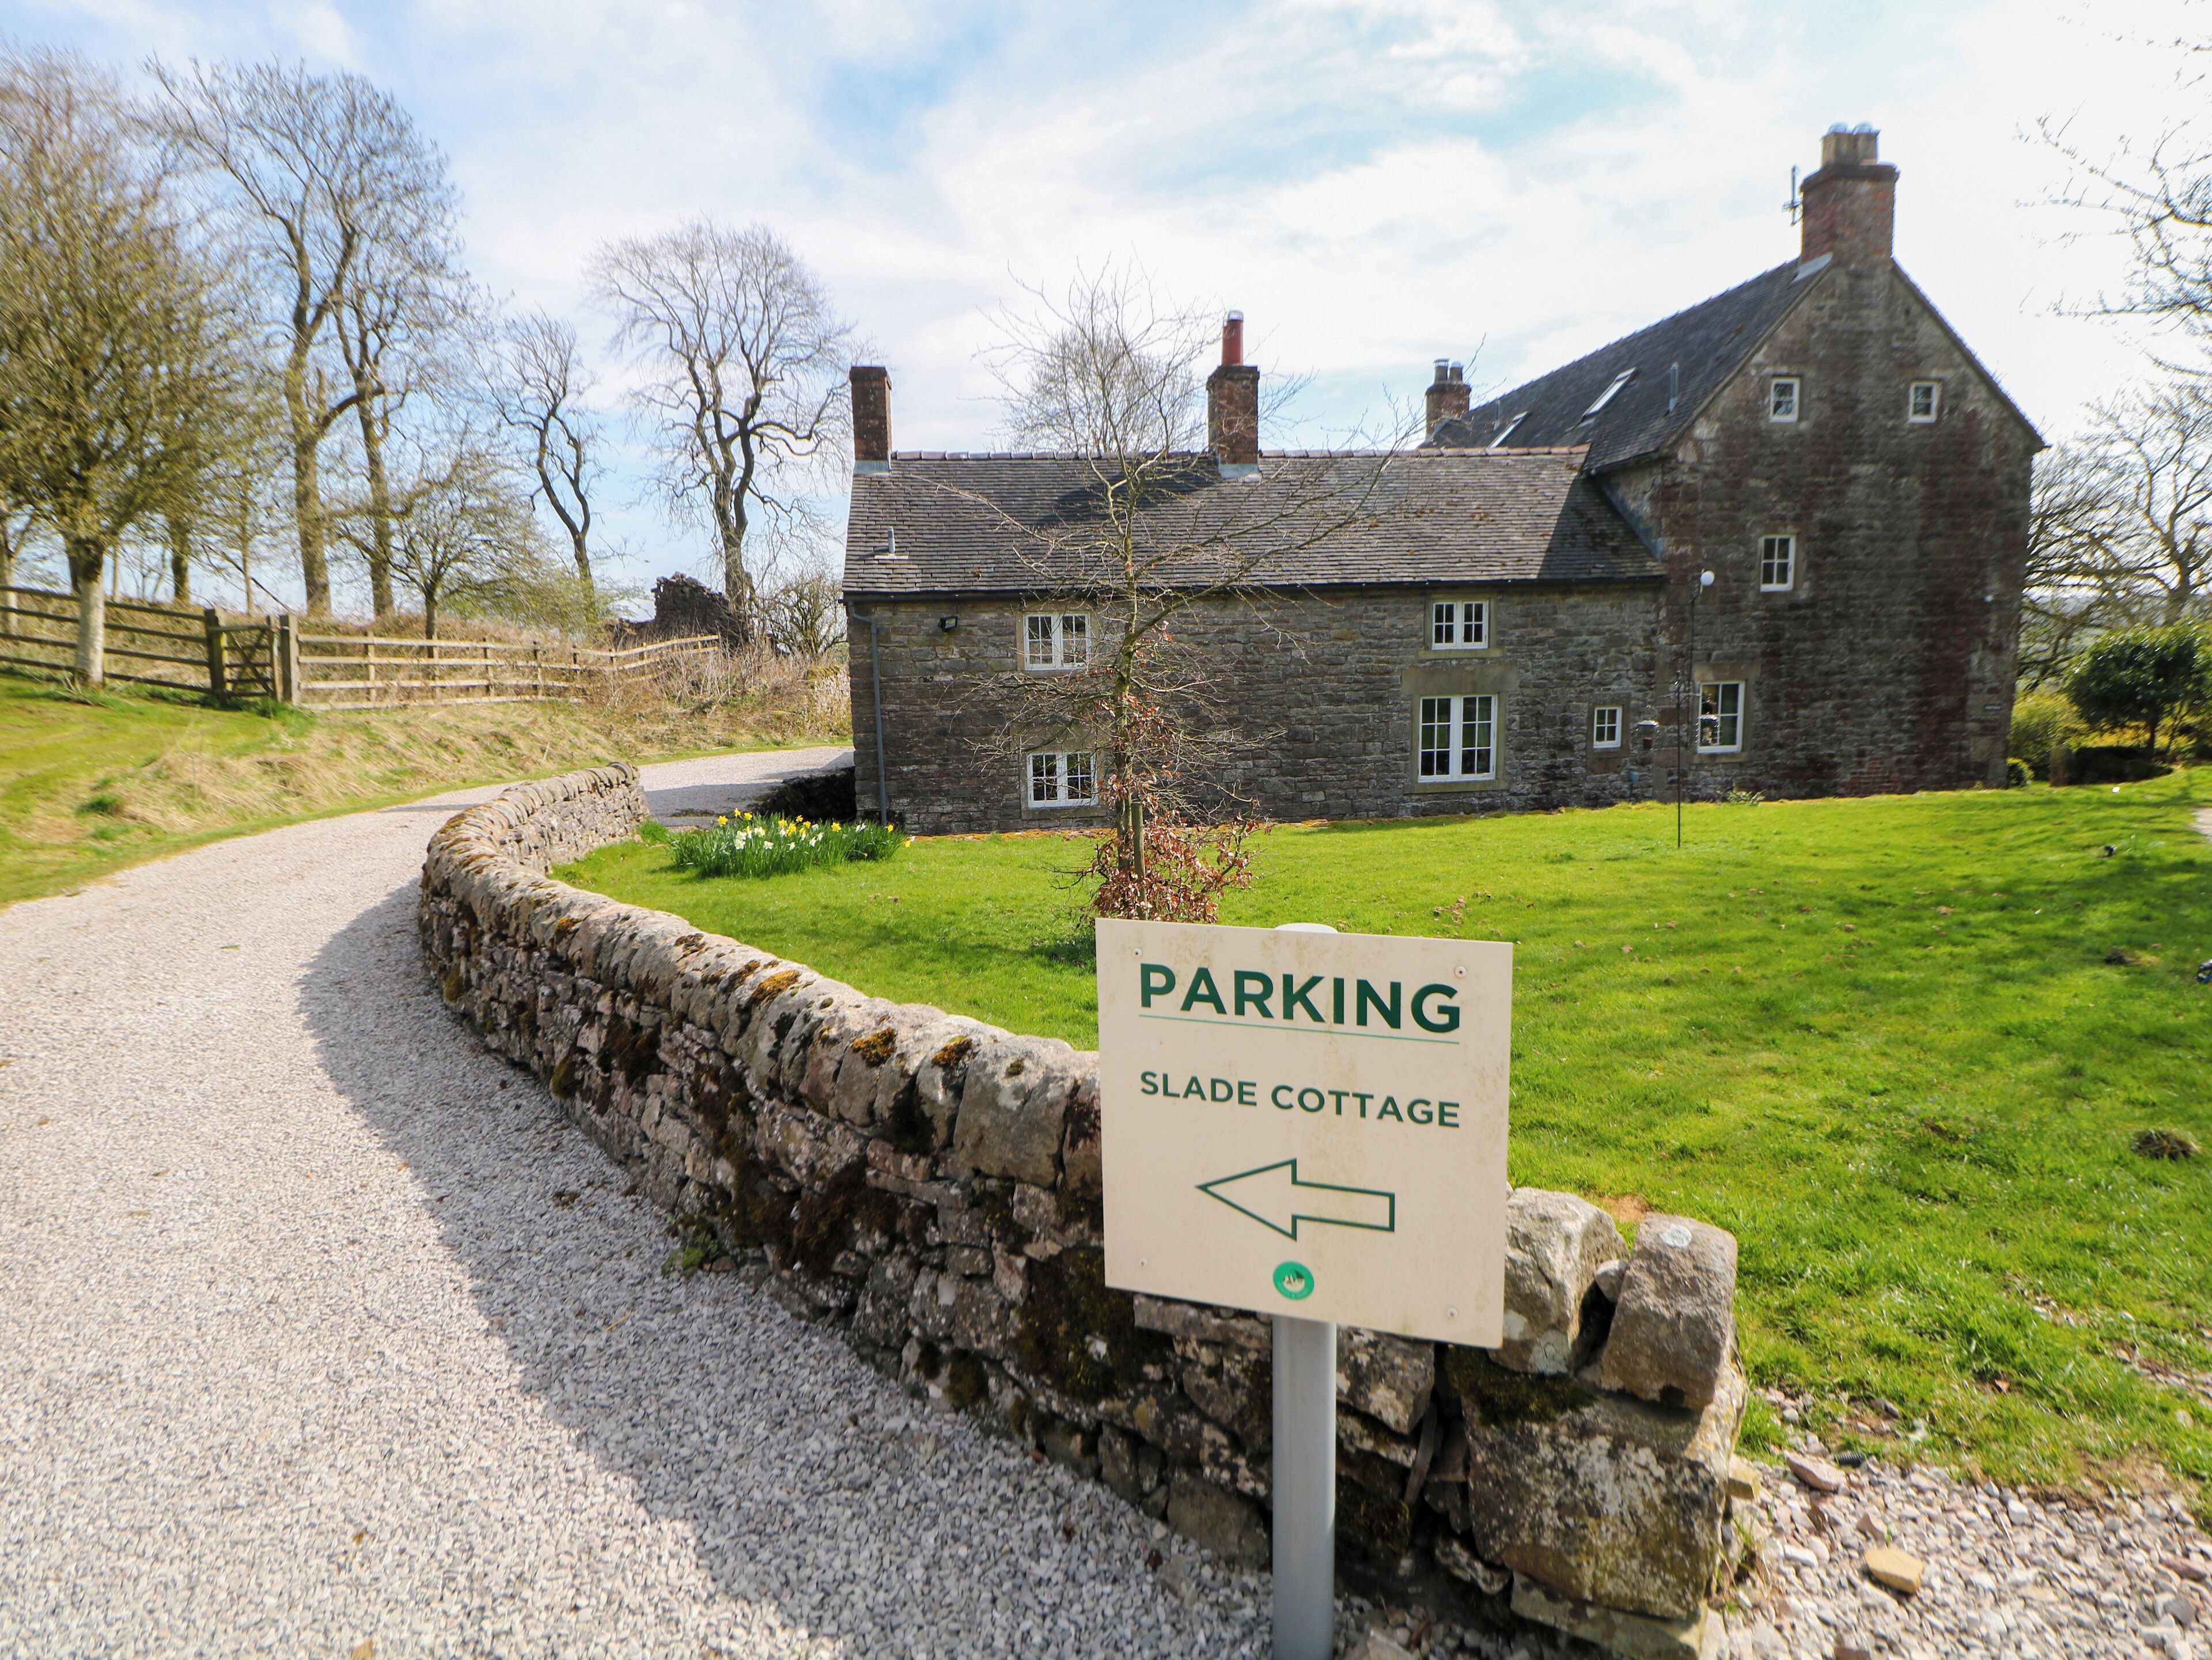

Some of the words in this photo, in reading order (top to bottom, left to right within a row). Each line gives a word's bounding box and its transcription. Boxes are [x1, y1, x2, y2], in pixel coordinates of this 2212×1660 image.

[1139, 962, 1460, 1034] PARKING
[1140, 1071, 1257, 1106] SLADE
[1271, 1085, 1460, 1128] COTTAGE
